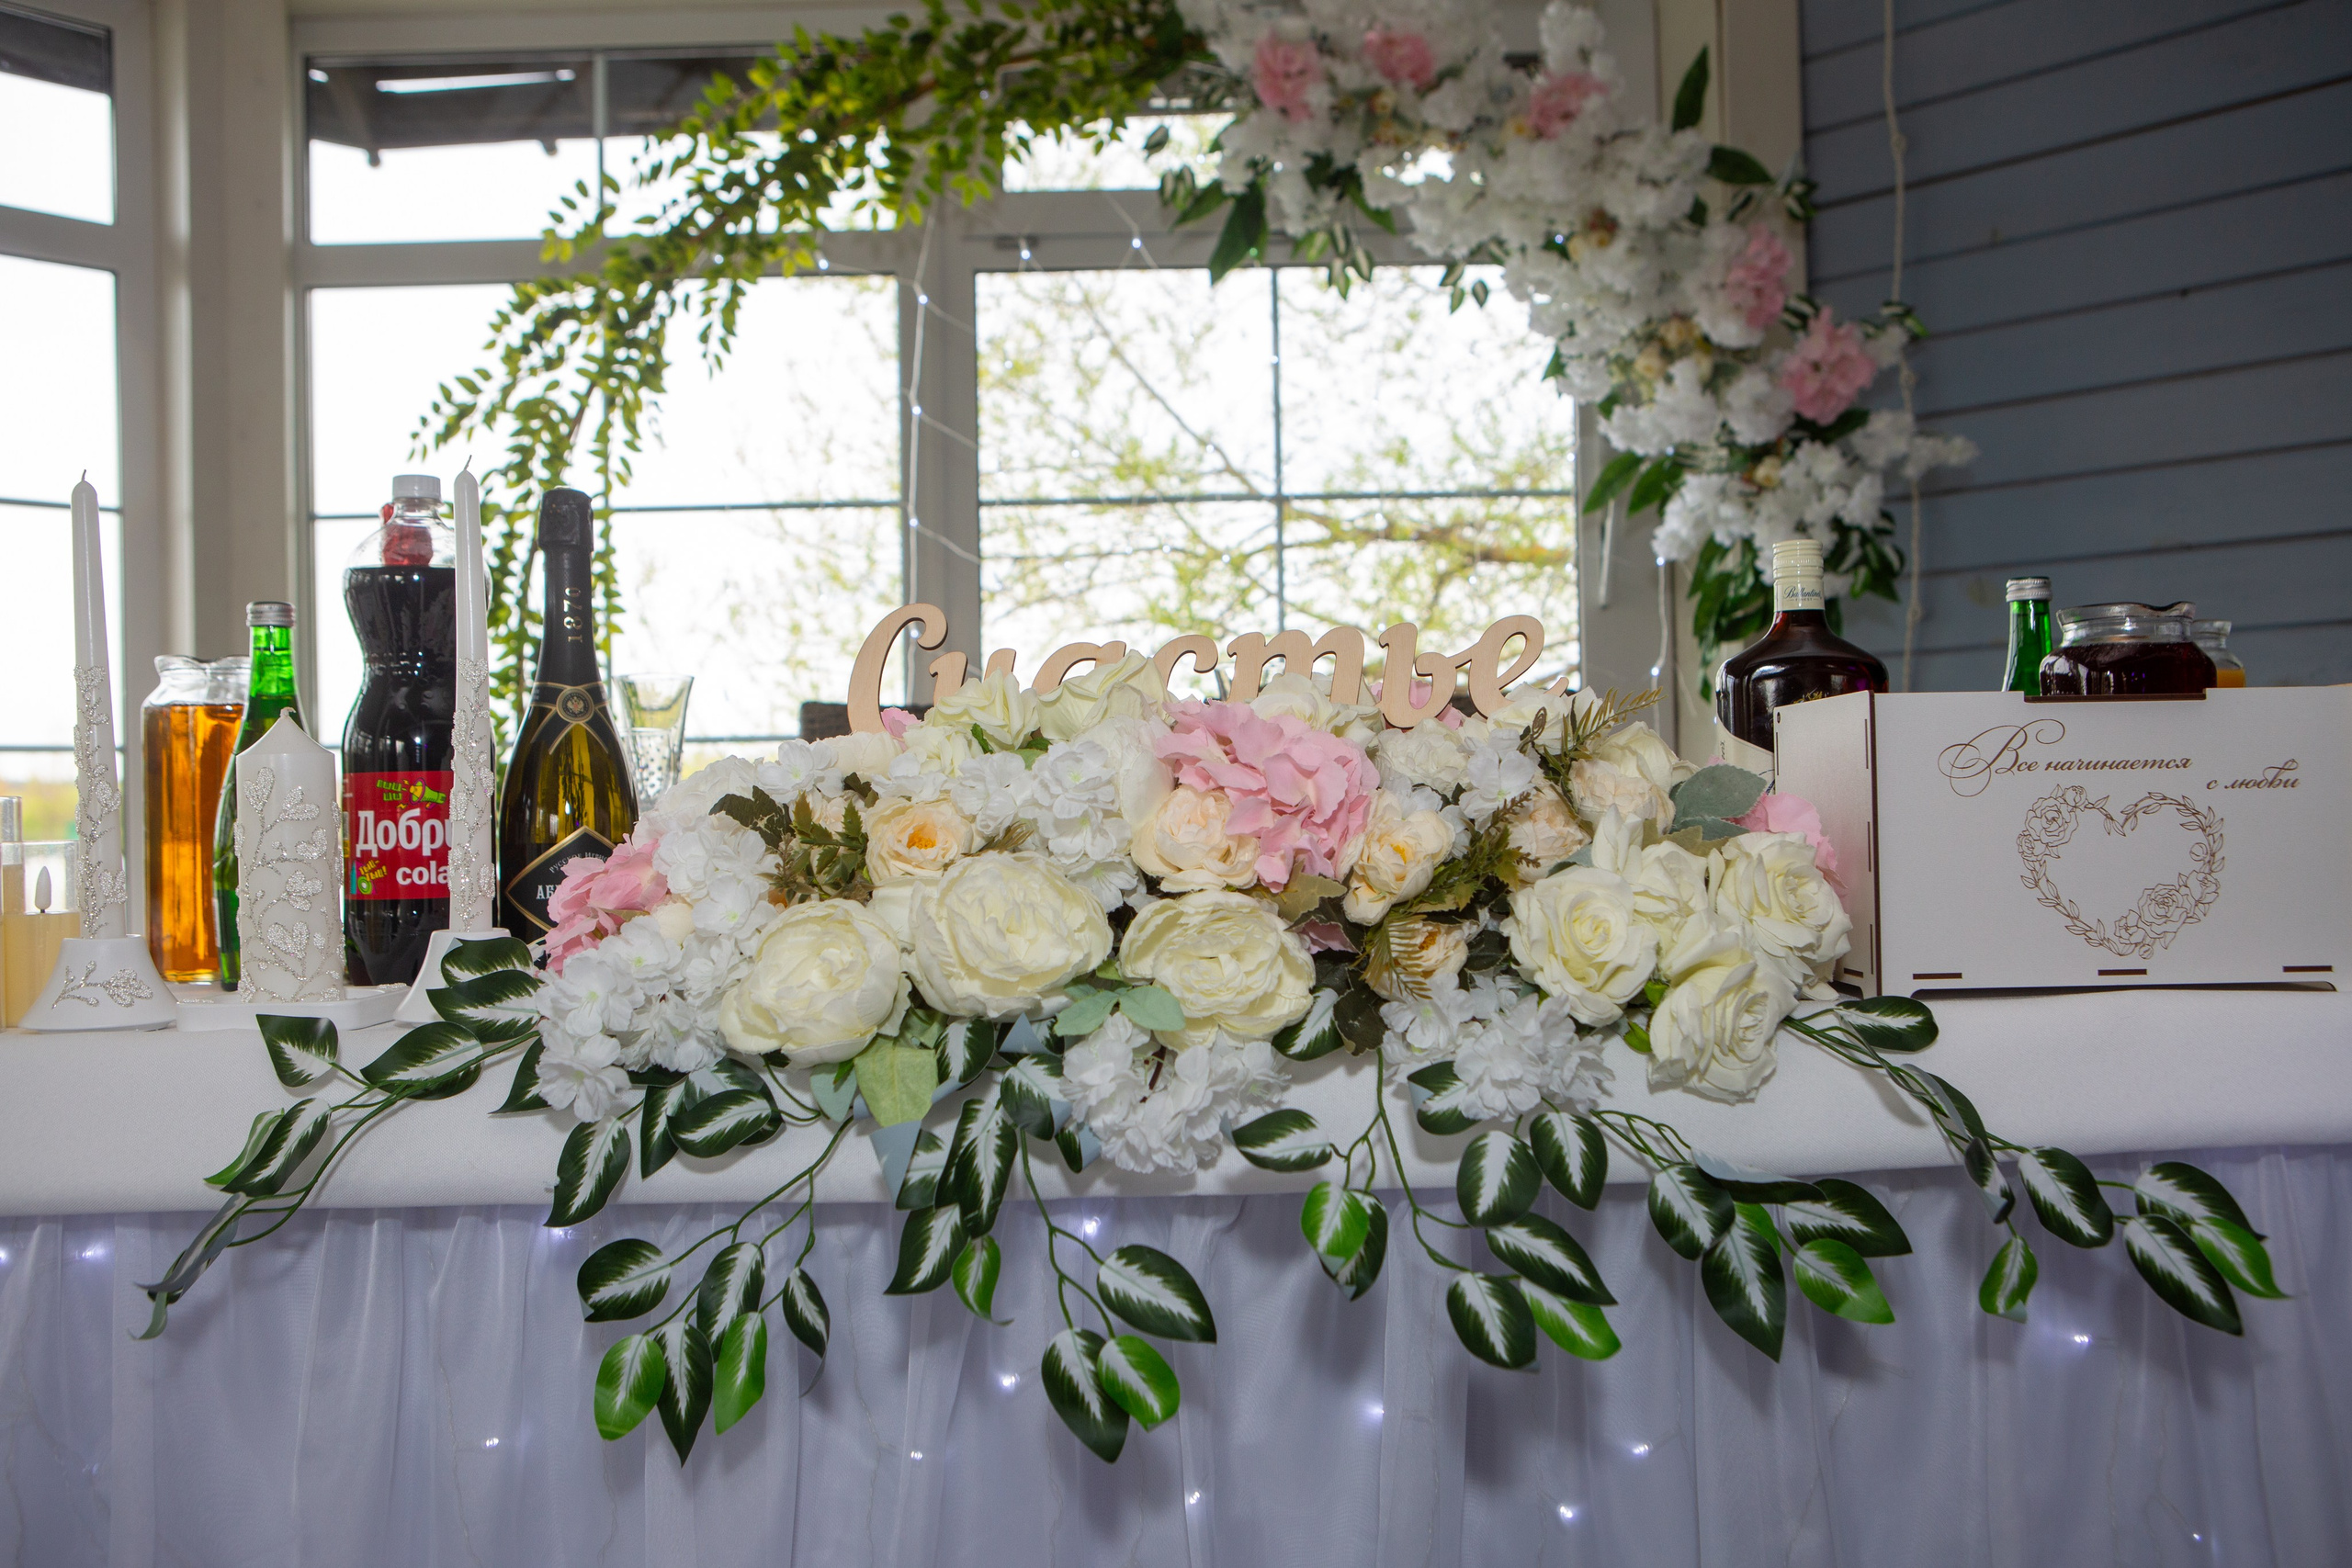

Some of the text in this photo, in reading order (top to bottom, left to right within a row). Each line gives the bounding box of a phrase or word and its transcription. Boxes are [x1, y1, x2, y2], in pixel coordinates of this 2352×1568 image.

[563, 587, 582, 642] 1870
[1938, 718, 2193, 797] Все начинается
[2206, 758, 2301, 790] с любви
[356, 807, 452, 858] Добр
[396, 861, 449, 886] cola
